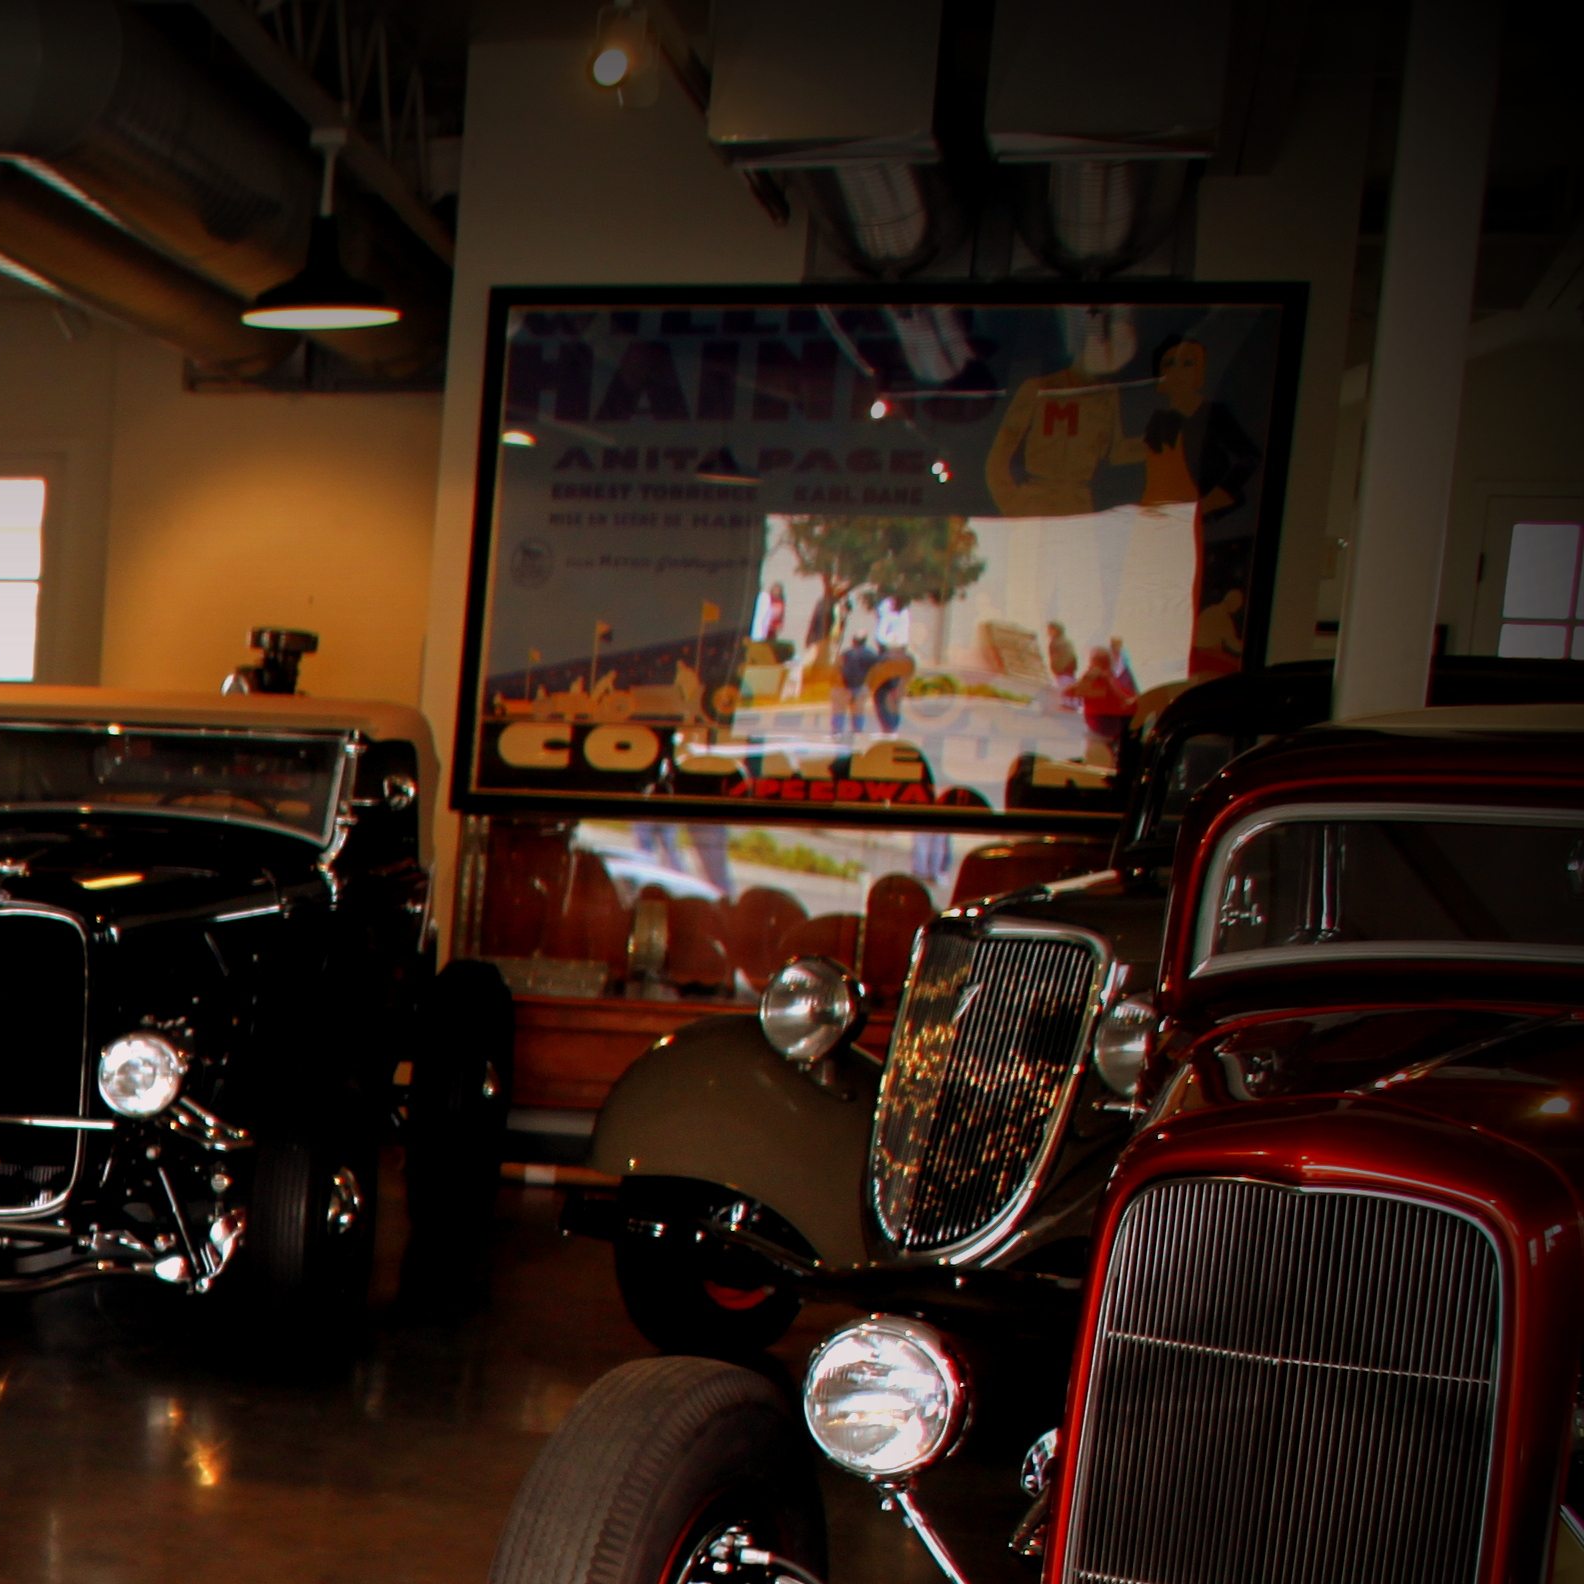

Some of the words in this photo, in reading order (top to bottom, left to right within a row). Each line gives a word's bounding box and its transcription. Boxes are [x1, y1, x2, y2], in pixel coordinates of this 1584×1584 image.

[1043, 400, 1079, 436] M
[553, 446, 739, 473] ANITA
[756, 447, 926, 475] PAGE
[729, 777, 972, 804] SPEEDWA
